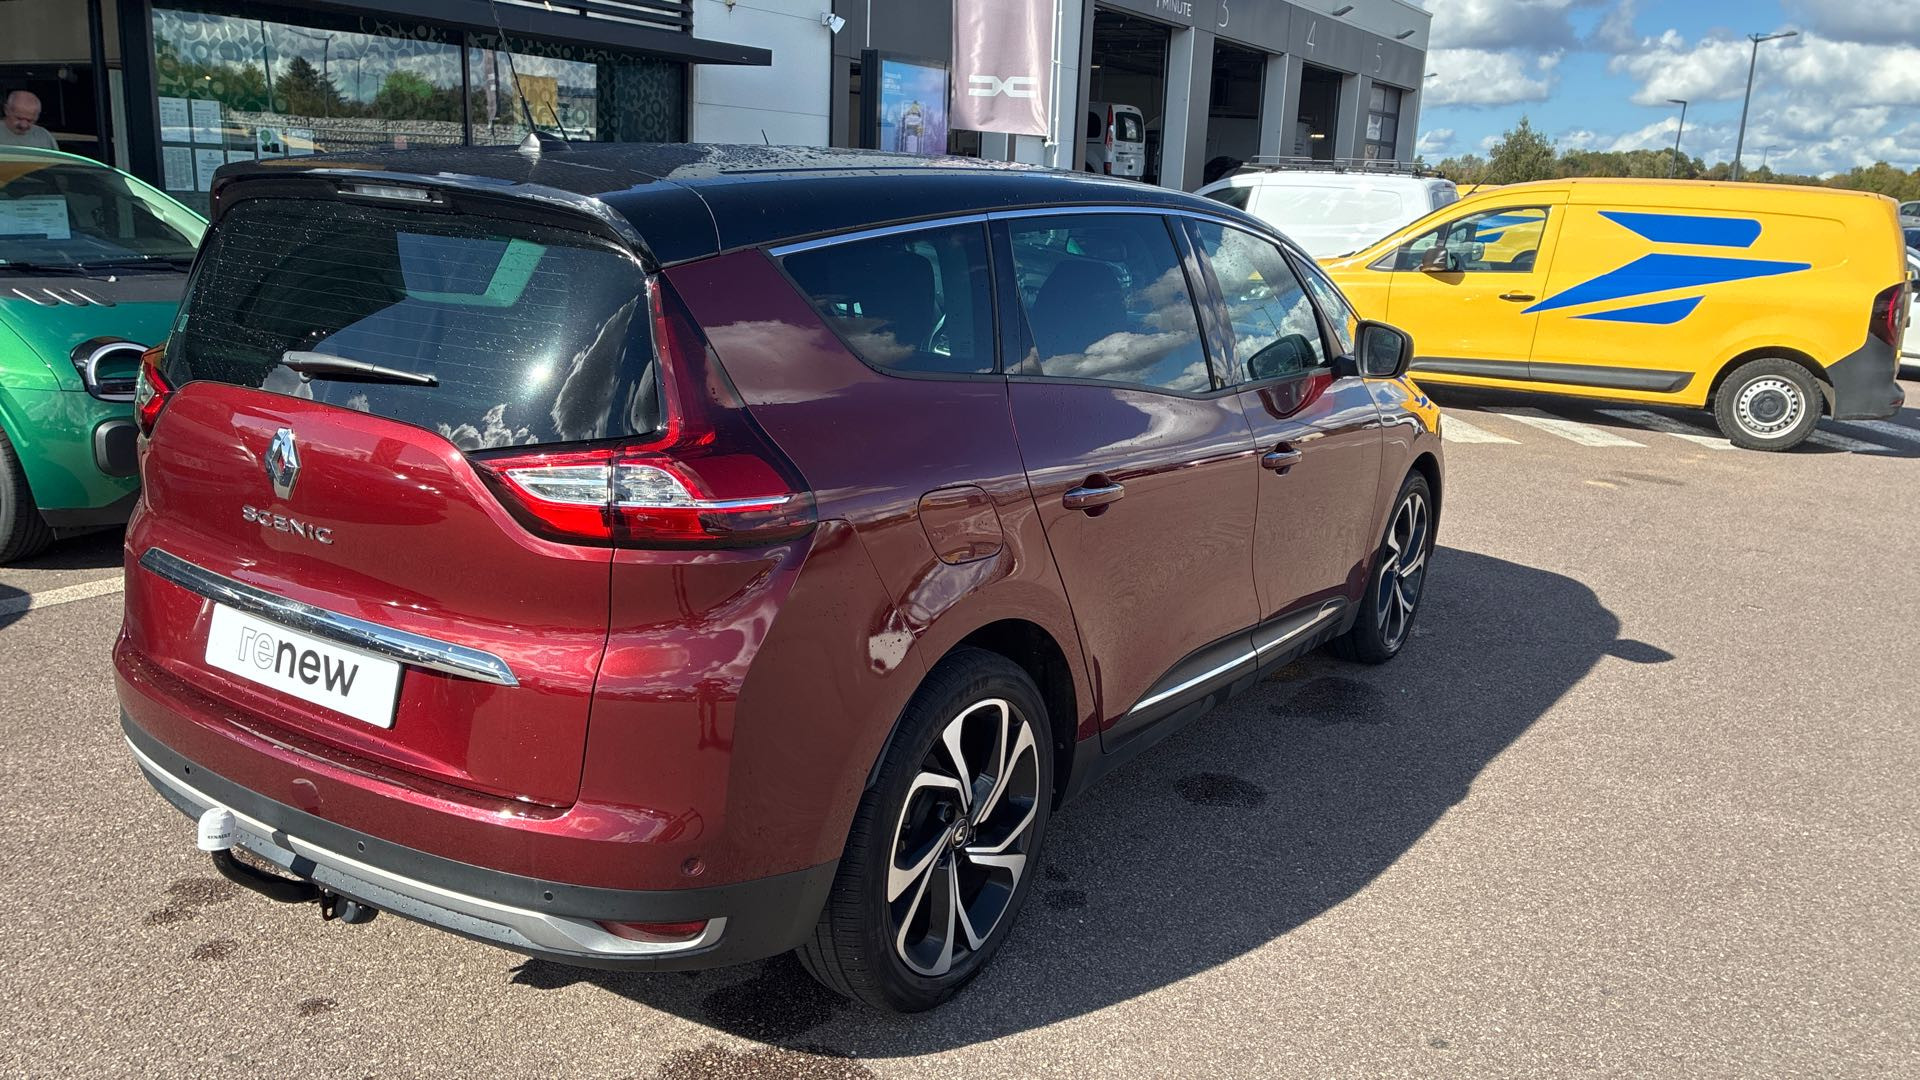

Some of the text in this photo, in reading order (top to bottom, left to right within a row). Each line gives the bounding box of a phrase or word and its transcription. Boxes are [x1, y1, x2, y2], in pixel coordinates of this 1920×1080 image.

[1162, 0, 1192, 17] MINUTE
[1218, 0, 1230, 28] 3
[1306, 20, 1317, 53] 4
[1375, 42, 1383, 73] 5
[242, 504, 335, 545] SCENIC
[238, 626, 360, 697] renew
